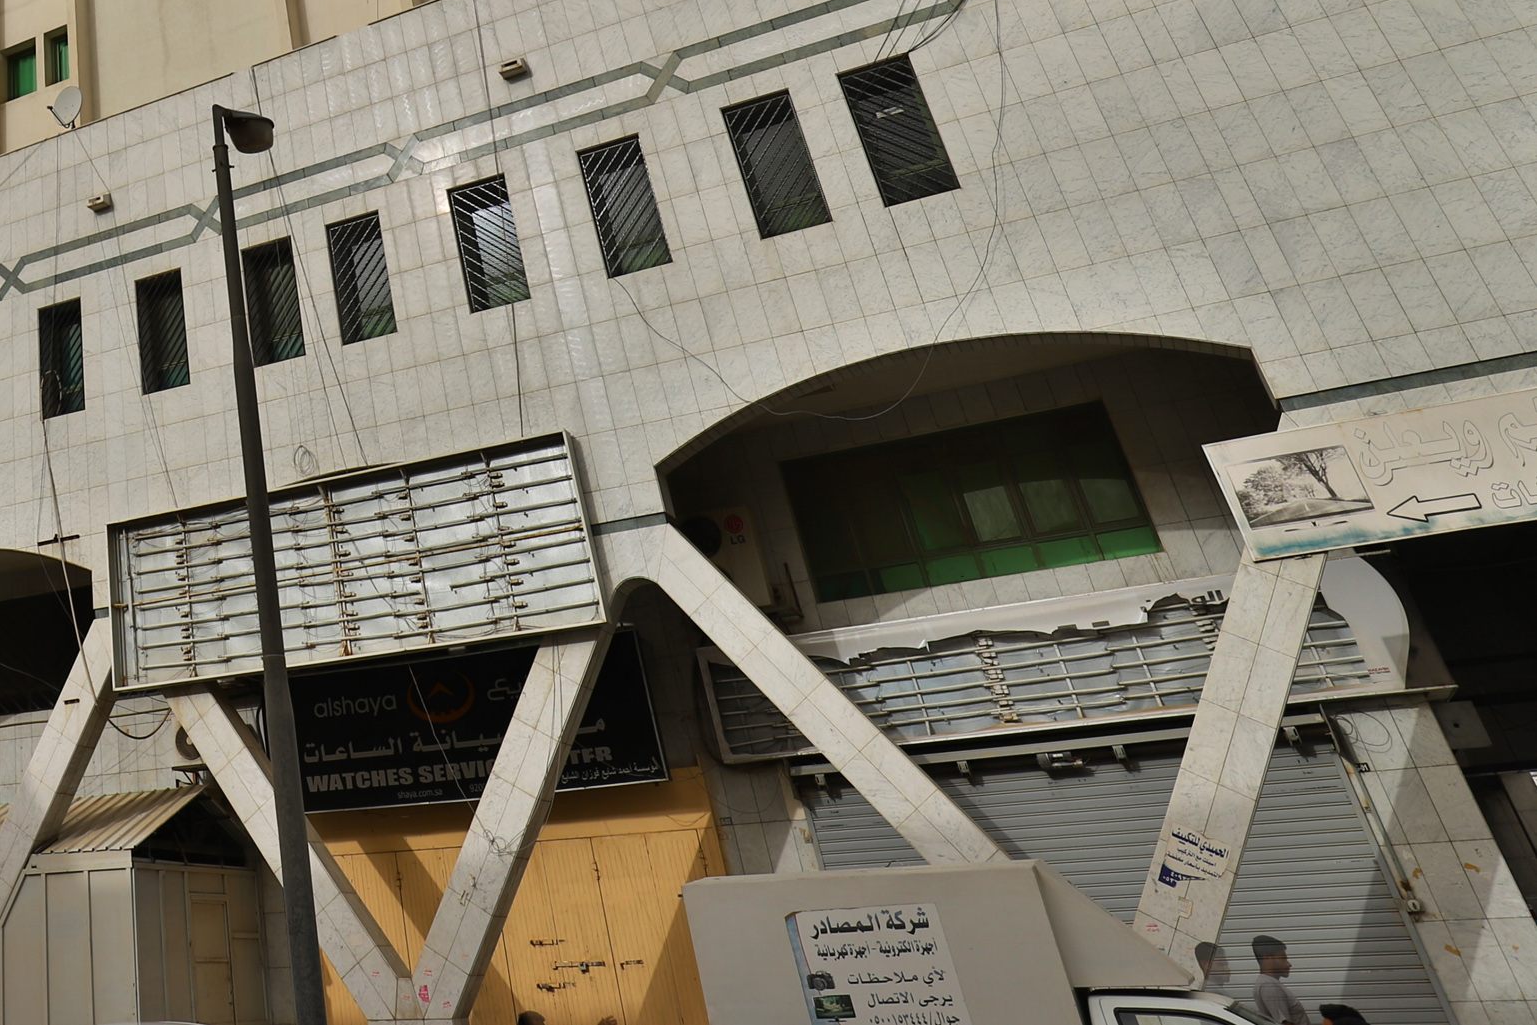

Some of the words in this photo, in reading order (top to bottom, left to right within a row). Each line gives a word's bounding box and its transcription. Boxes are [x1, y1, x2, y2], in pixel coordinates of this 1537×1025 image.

[729, 534, 747, 545] LG
[313, 693, 398, 719] alshaya
[304, 736, 403, 763] الساعات
[306, 766, 414, 793] WATCHES
[418, 759, 496, 783] SERVIC
[1172, 827, 1201, 846] للتكييف
[810, 912, 881, 939] المصادر
[881, 907, 930, 935] شركة
[848, 941, 872, 958] أجهزة
[916, 937, 938, 955] أجهزة
[847, 970, 919, 985] ملاحظات
[922, 965, 947, 987] لأي
[867, 991, 915, 1008] الاتصال
[919, 993, 954, 1007] يرجى
